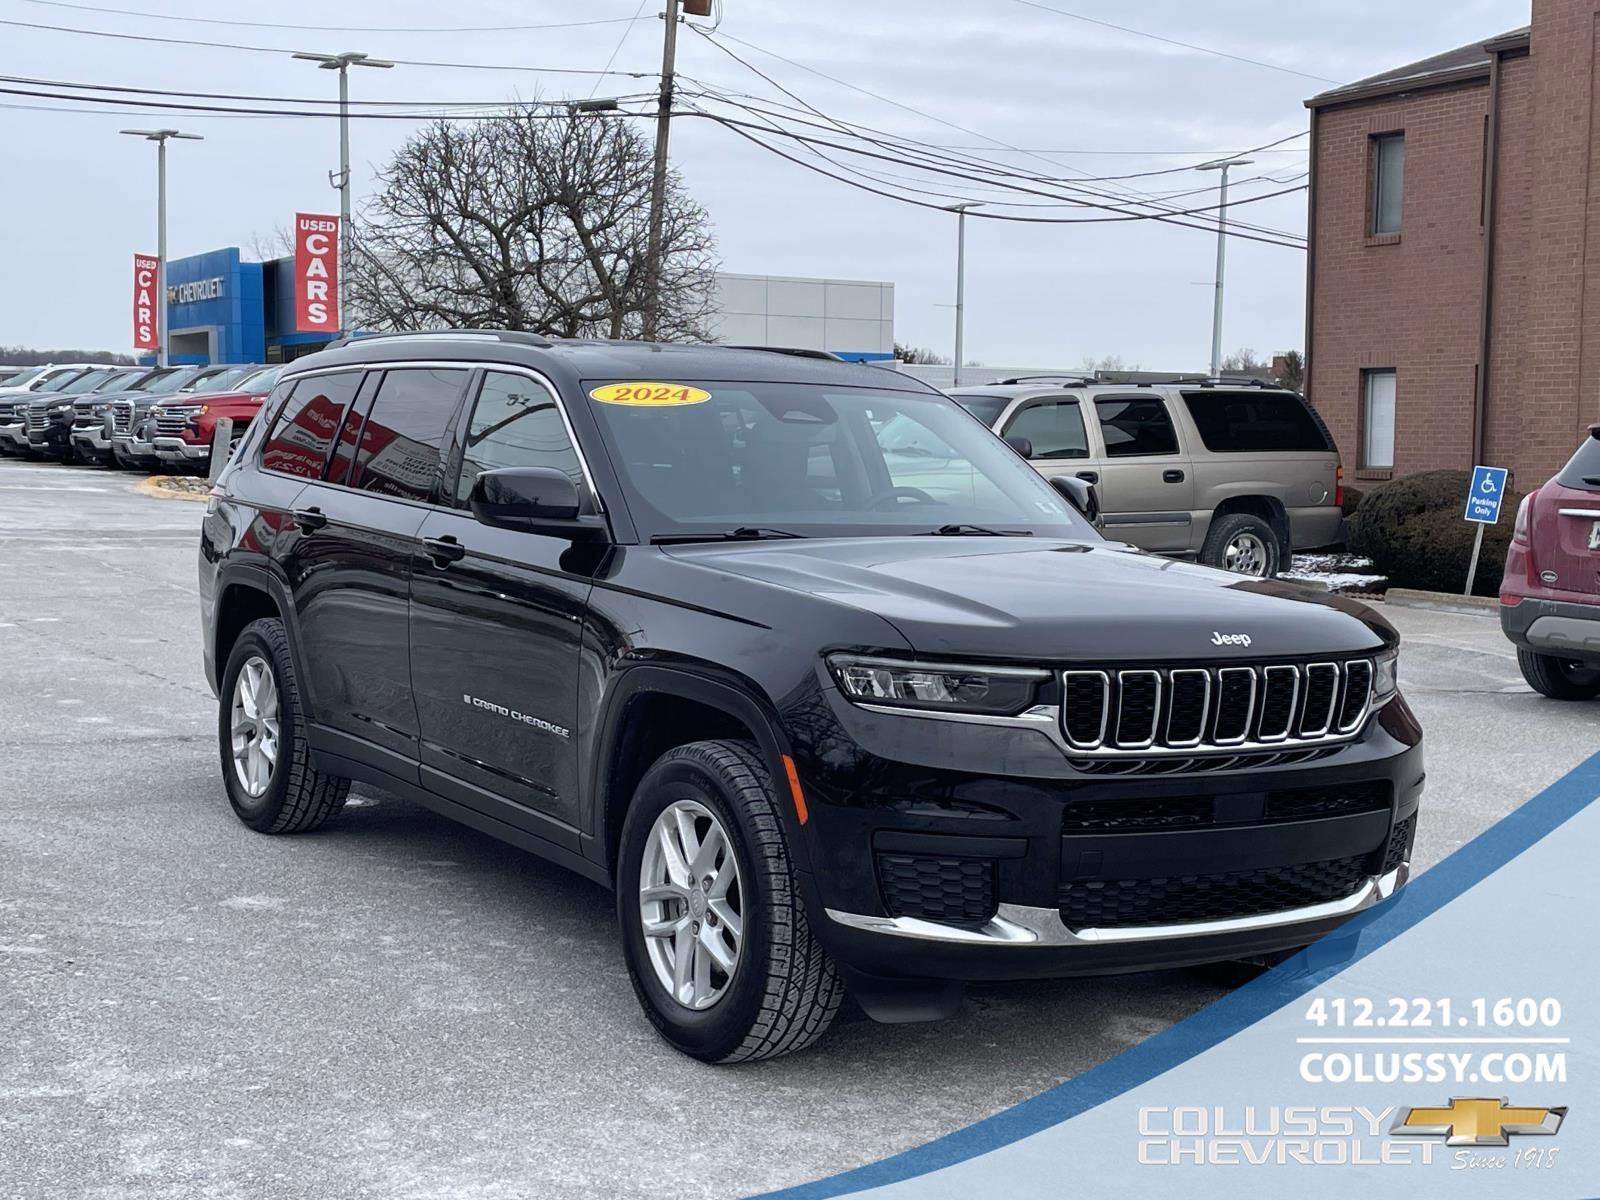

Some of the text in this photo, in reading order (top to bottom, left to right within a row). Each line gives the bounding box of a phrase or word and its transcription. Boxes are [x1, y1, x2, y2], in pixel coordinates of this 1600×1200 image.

[300, 219, 336, 232] USED
[136, 258, 157, 269] USED
[305, 233, 329, 324] CARS
[179, 277, 224, 303] CHEVROLET
[138, 270, 151, 343] CARS
[614, 387, 690, 401] 2024
[1471, 496, 1497, 508] Parking
[1474, 506, 1491, 516] Only
[1211, 631, 1252, 647] Jeep
[472, 697, 570, 738] GRAND CHEROKEE
